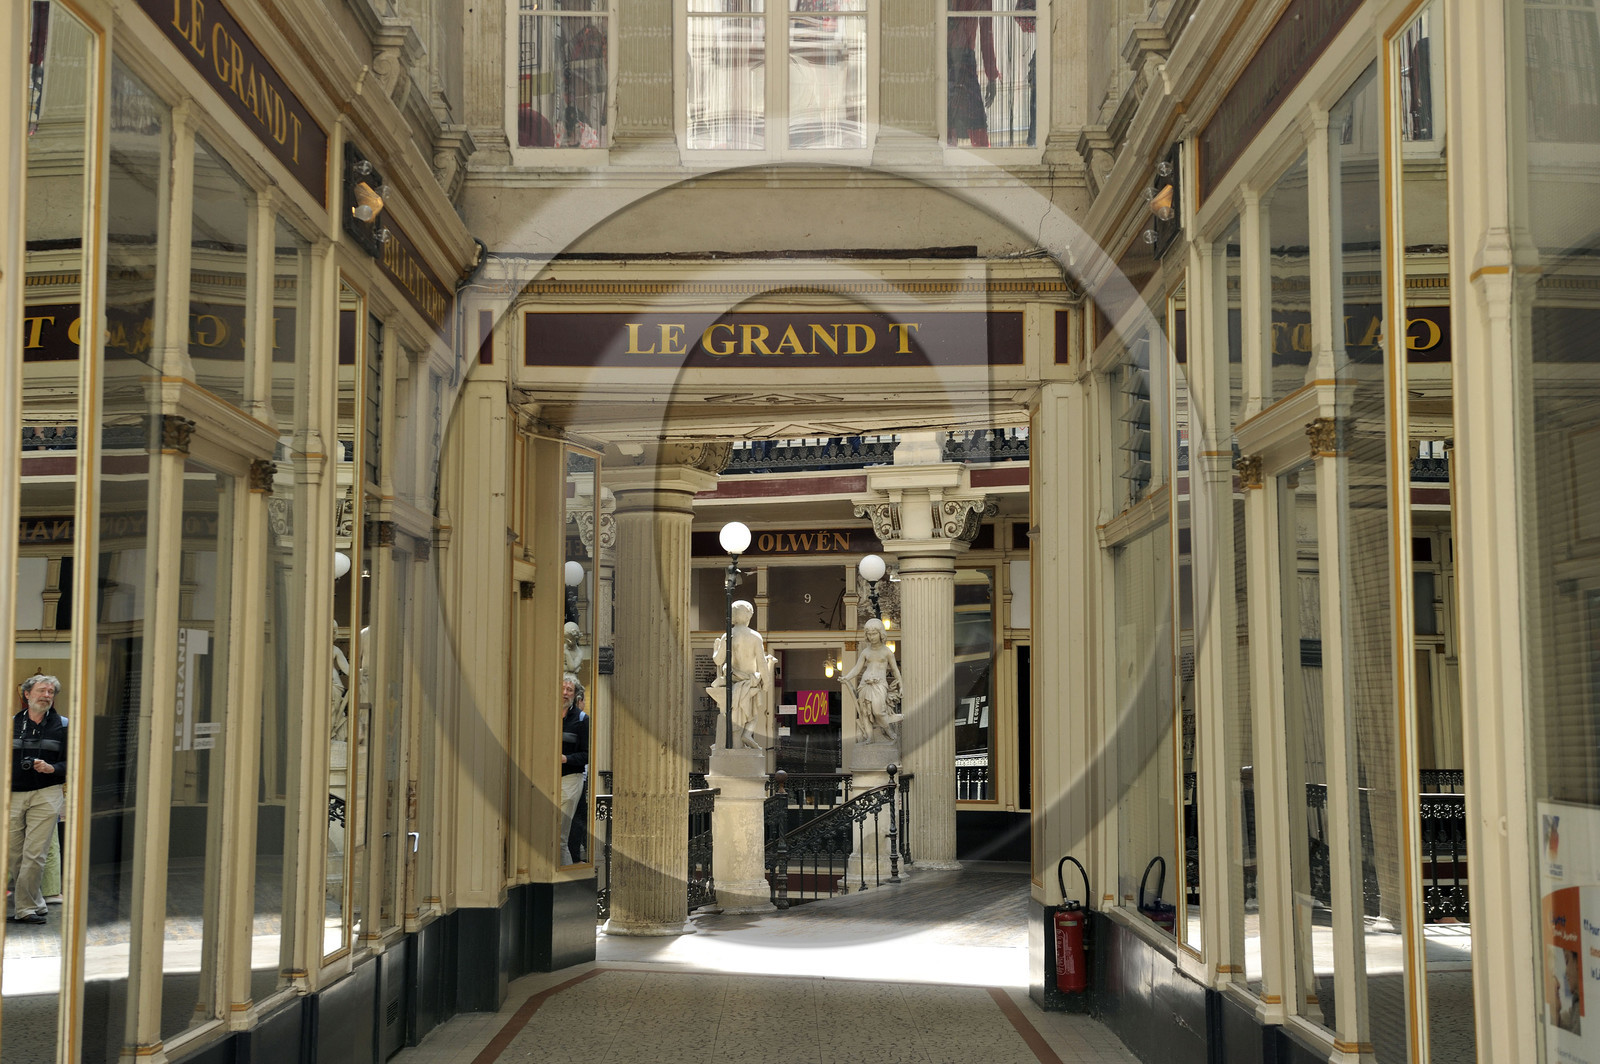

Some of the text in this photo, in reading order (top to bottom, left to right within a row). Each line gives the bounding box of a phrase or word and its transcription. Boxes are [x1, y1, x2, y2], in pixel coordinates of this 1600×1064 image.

[171, 0, 302, 165] LE GRAND T
[383, 225, 446, 334] BILLETTERIE
[625, 323, 919, 356] LE GRAND T
[804, 593, 812, 604] 9
[176, 628, 186, 715] GRAND
[798, 691, 828, 723] -60%
